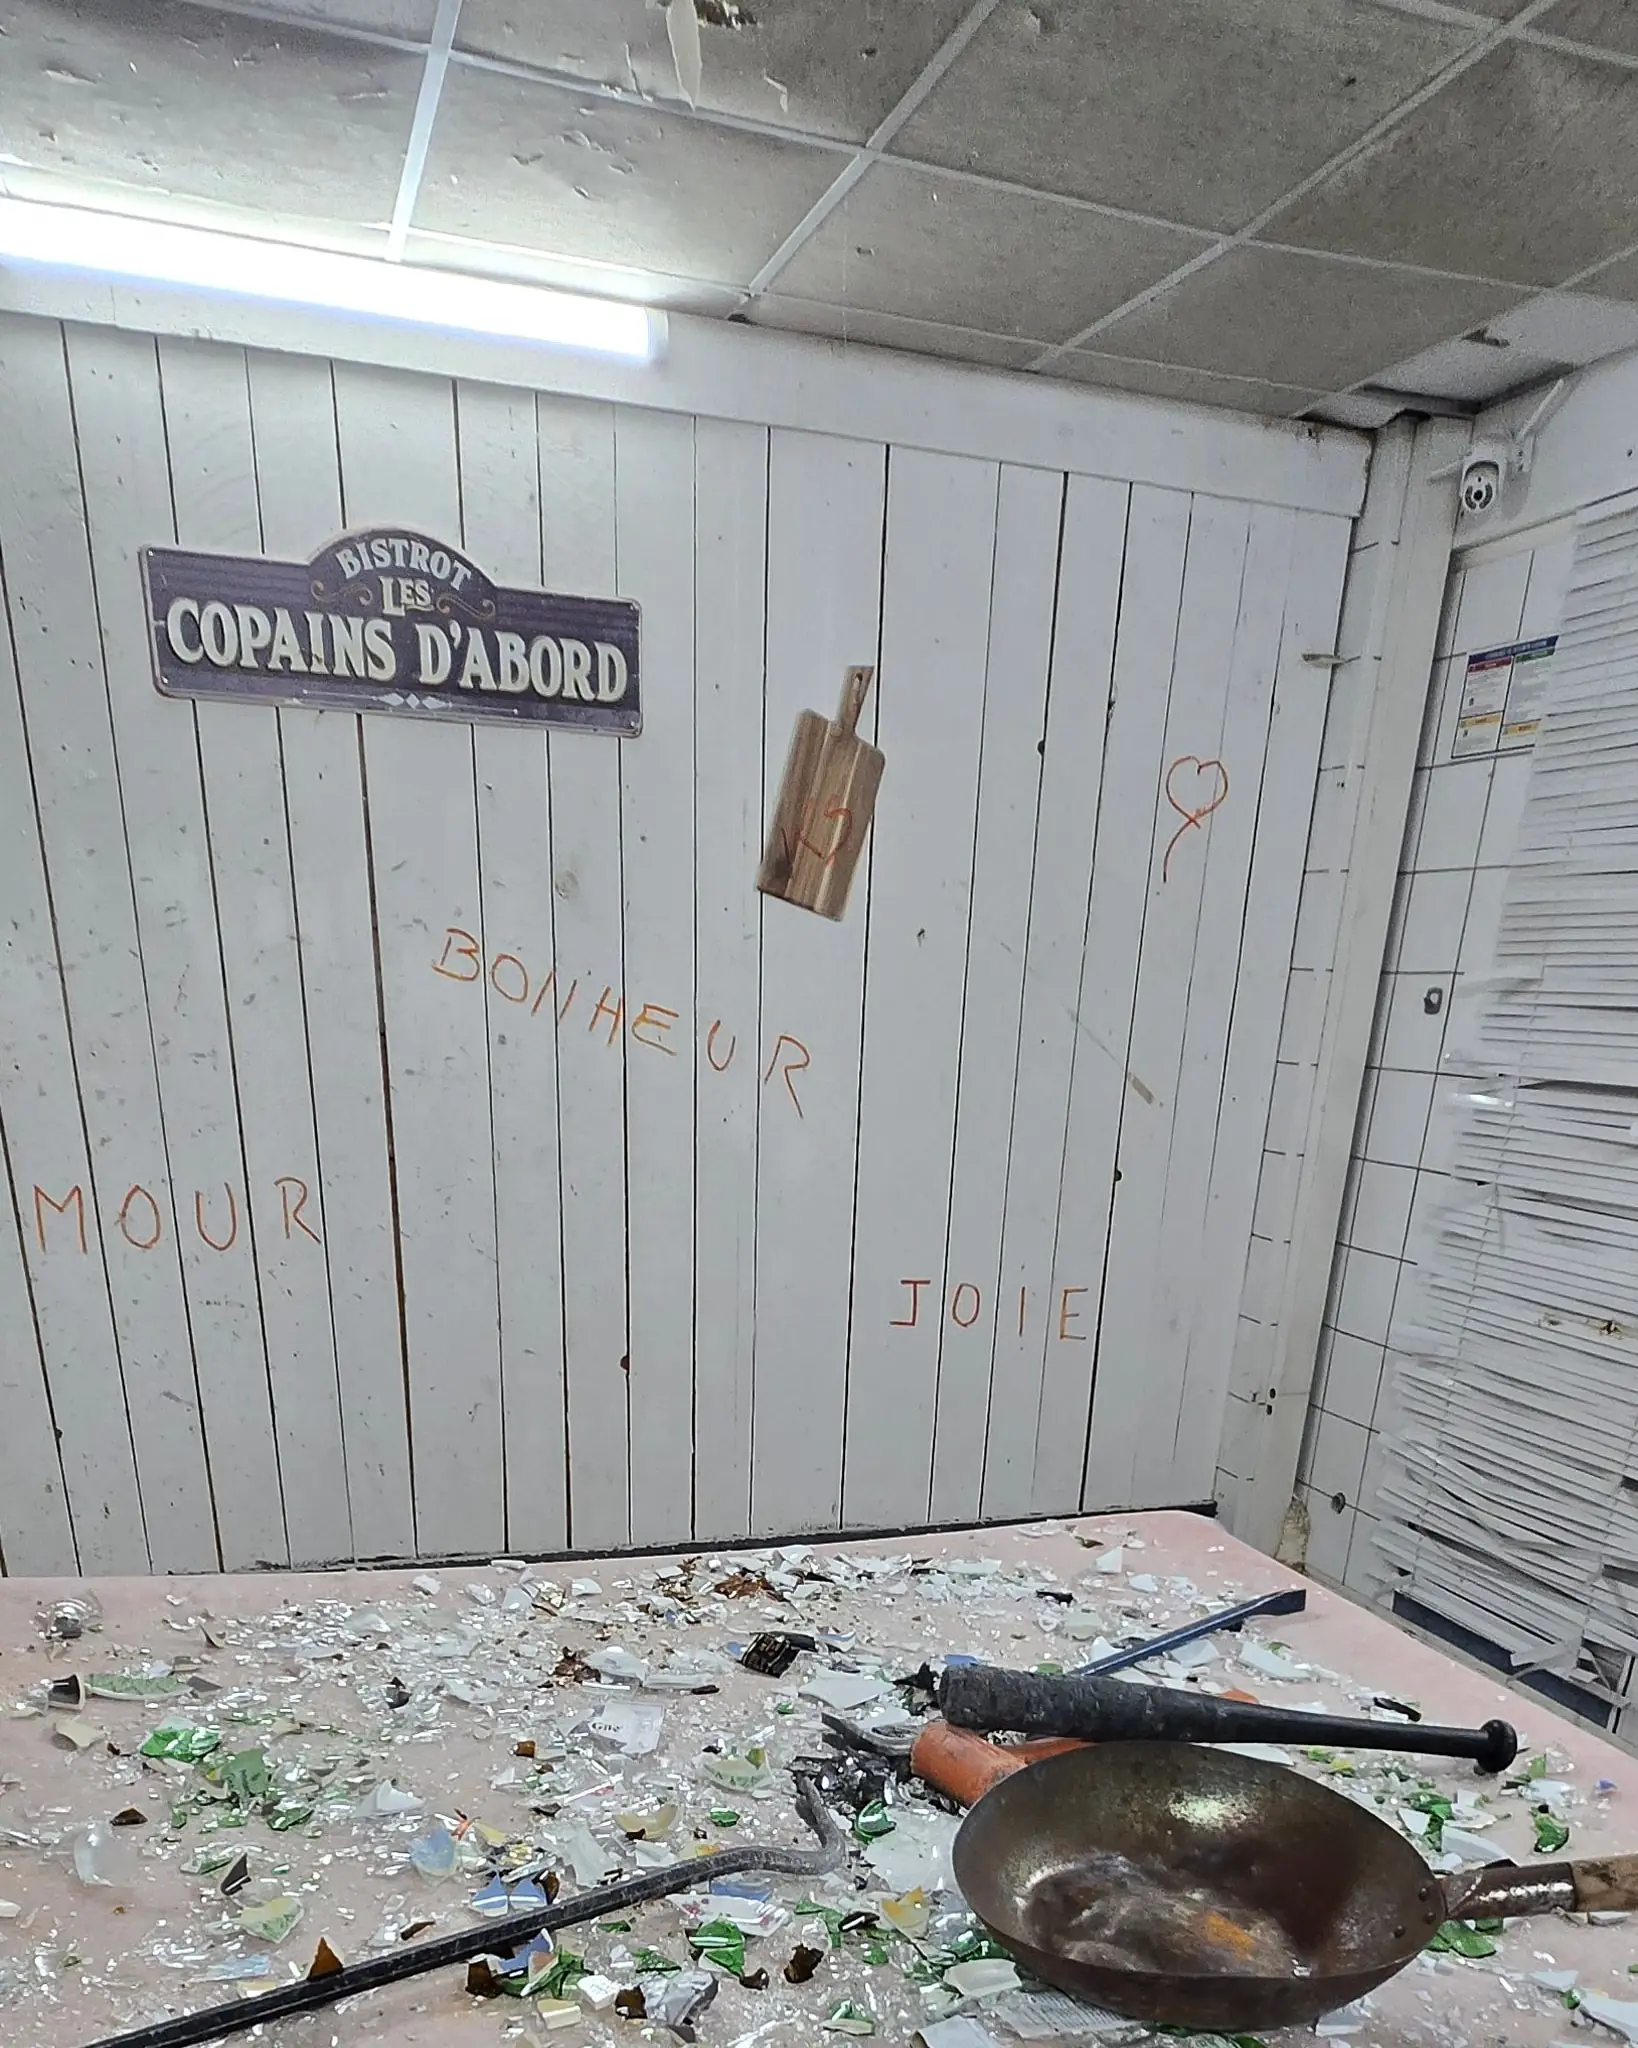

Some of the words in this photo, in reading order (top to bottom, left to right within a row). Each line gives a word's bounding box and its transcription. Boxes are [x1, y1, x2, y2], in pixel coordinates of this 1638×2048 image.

[335, 537, 472, 590] BISTROT
[379, 576, 435, 617] LES
[166, 597, 397, 682] COPAINS
[417, 622, 628, 703] D'ABORD
[432, 927, 810, 1119] BONHEUR
[33, 1176, 322, 1255] MOUR
[889, 1279, 1089, 1340] JOIE
